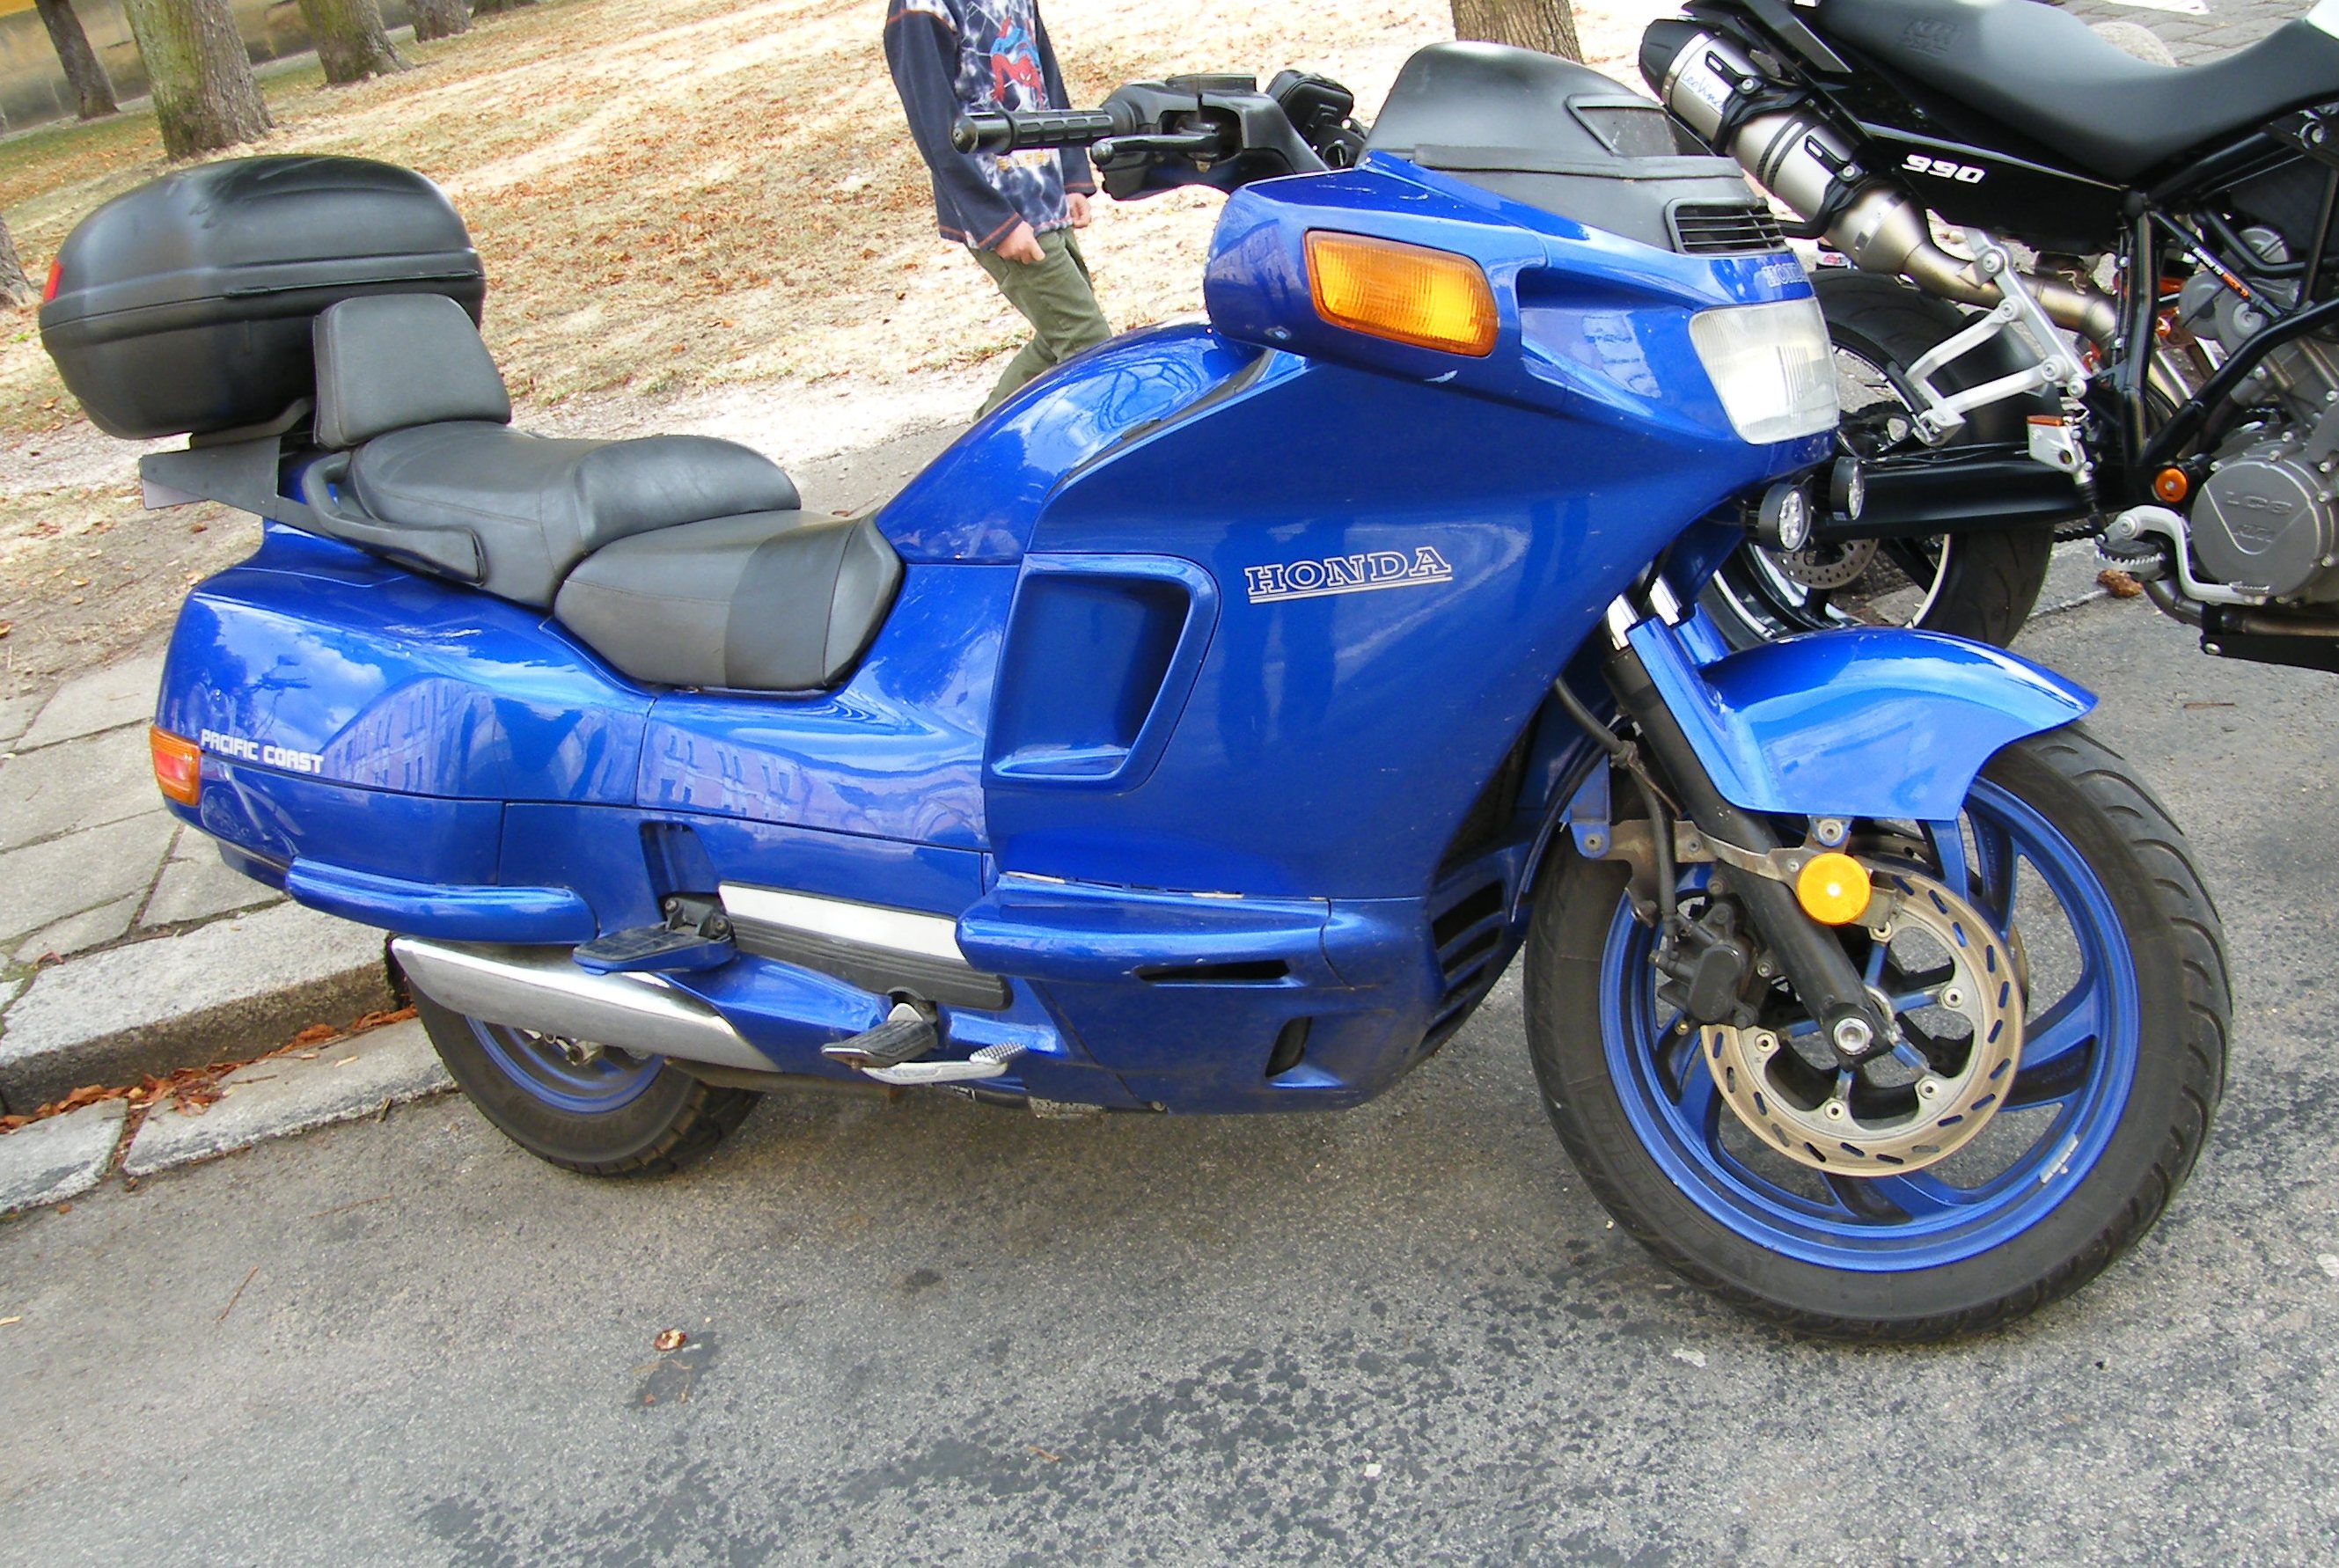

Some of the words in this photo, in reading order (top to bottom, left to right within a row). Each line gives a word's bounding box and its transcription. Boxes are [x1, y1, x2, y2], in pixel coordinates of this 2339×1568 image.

[1901, 154, 1985, 184] 990
[1243, 546, 1452, 597] HONDA
[201, 728, 259, 761] PACIFIC
[263, 744, 324, 774] COAST
